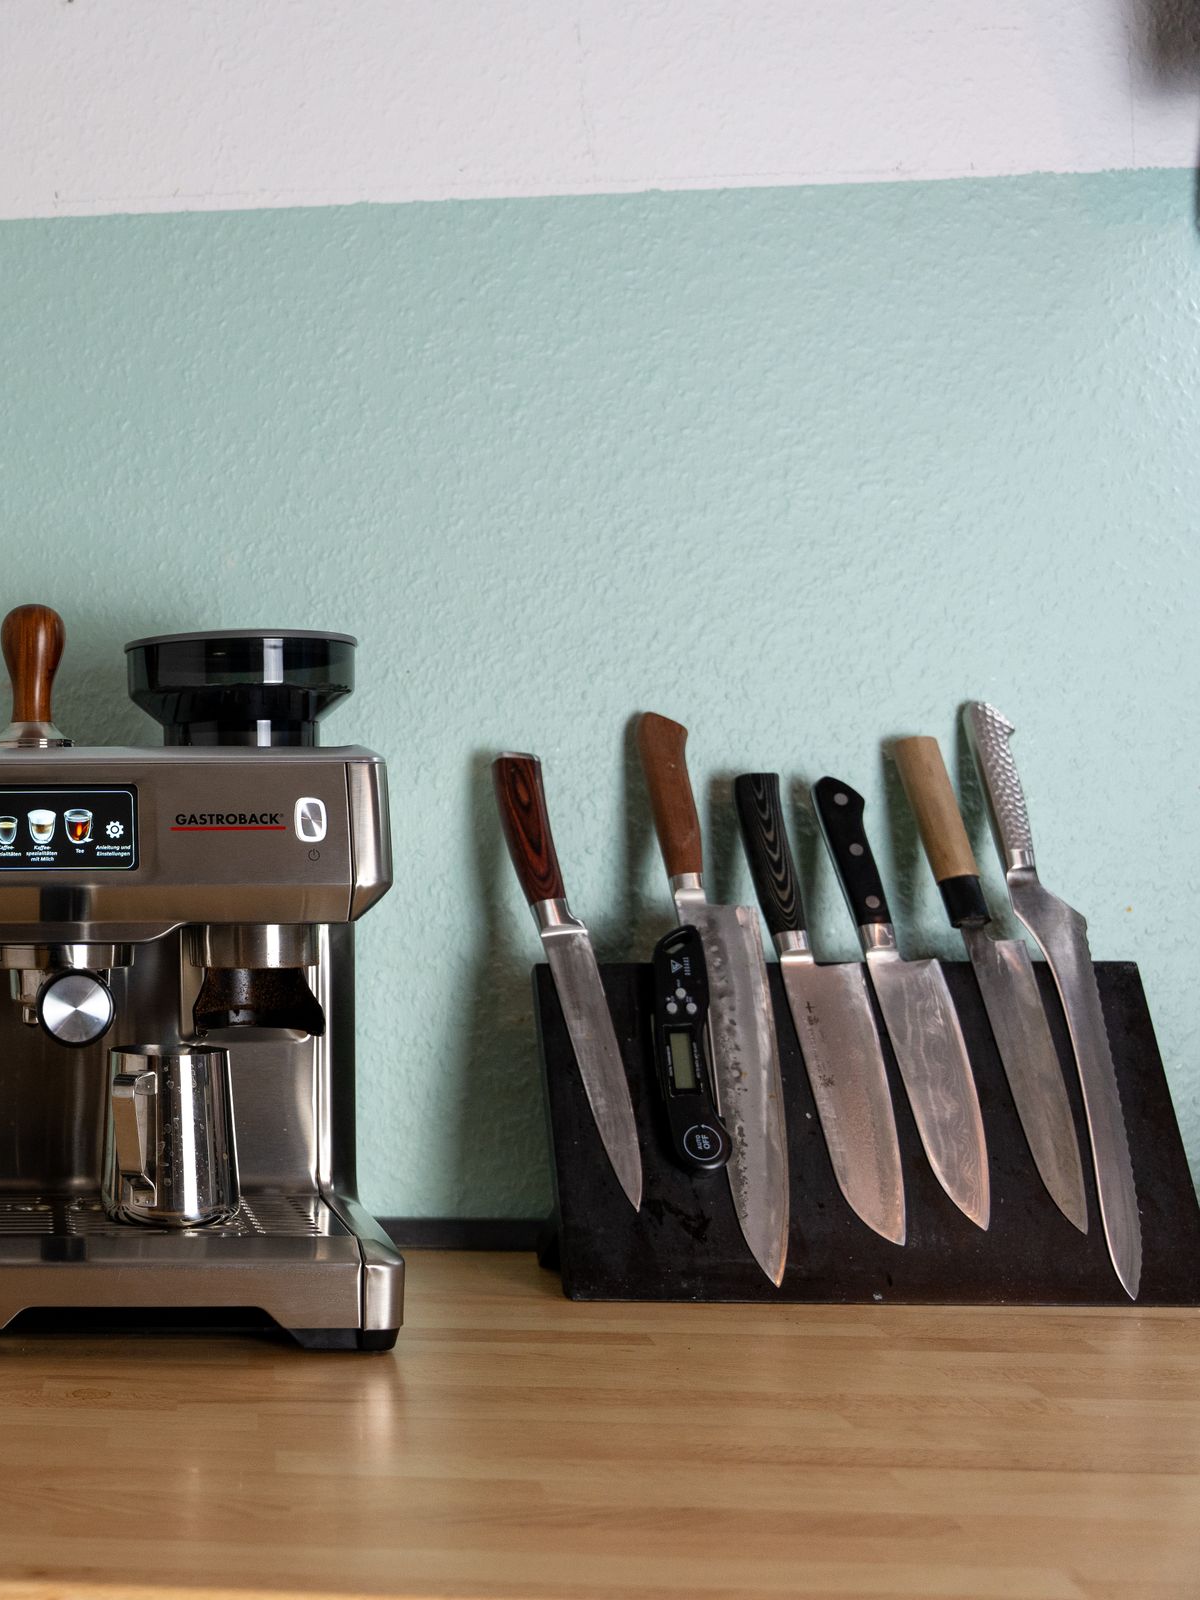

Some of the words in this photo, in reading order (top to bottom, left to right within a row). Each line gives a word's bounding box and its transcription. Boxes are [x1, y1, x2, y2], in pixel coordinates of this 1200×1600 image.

[175, 813, 280, 825] GASTROBACK
[695, 1134, 703, 1150] AUTO
[701, 1134, 711, 1150] OFF
